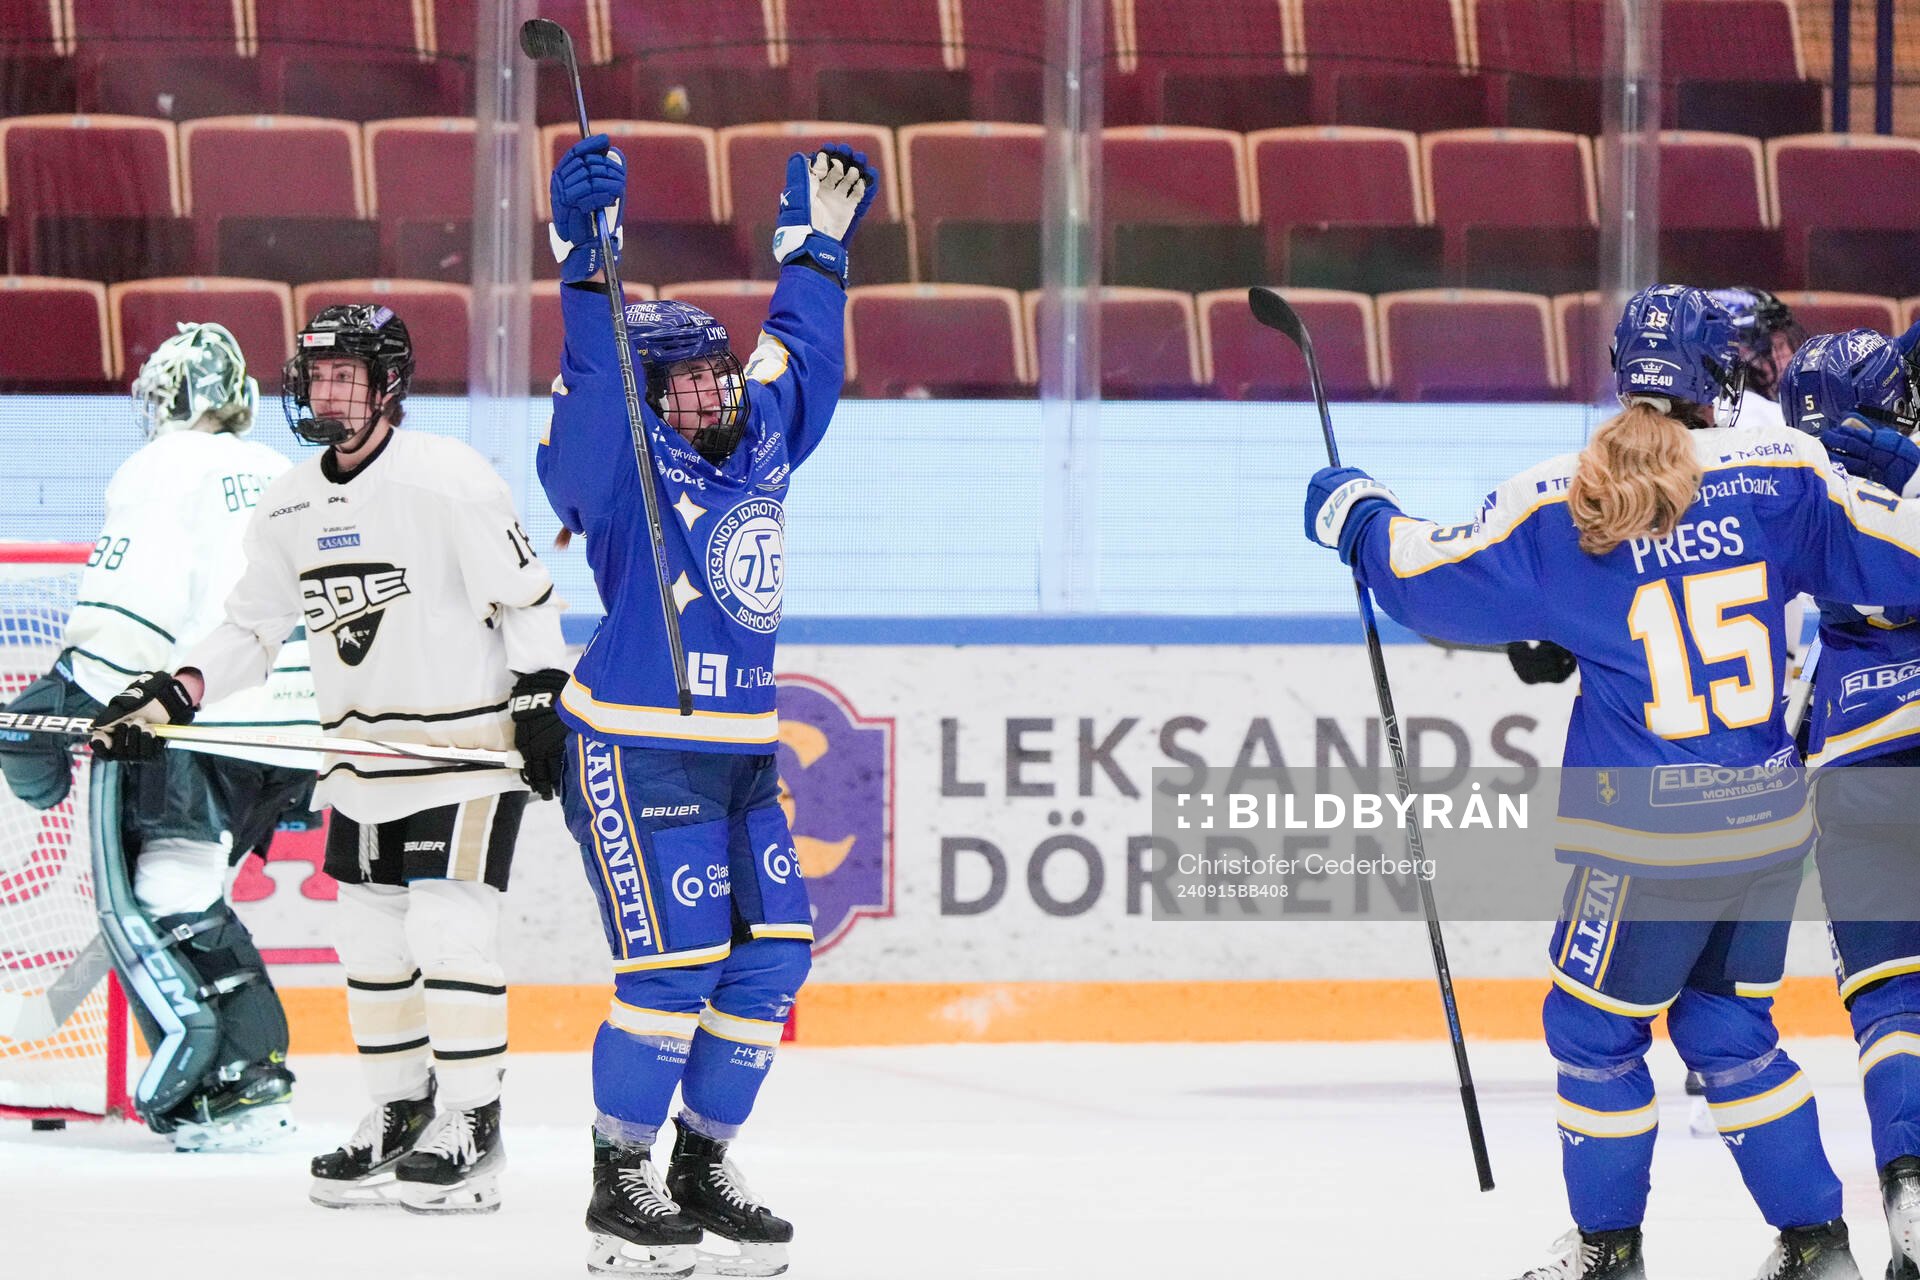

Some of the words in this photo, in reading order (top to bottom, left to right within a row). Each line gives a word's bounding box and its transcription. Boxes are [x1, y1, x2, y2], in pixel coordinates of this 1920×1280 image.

[1647, 311, 1668, 328] 15
[706, 327, 728, 341] LYKO
[1631, 373, 1673, 387] SAFE4U
[1805, 395, 1815, 411] 5
[1629, 516, 1744, 574] PRESS
[299, 567, 411, 633] SDE
[1627, 561, 1774, 740] 15
[941, 714, 1540, 799] LEKSANDS
[1702, 782, 1764, 799] MONTAGE
[641, 805, 700, 818] BAUER
[1736, 810, 1772, 825] BAUER
[941, 810, 1420, 917] DÖRREN
[121, 914, 201, 1019] CCM
